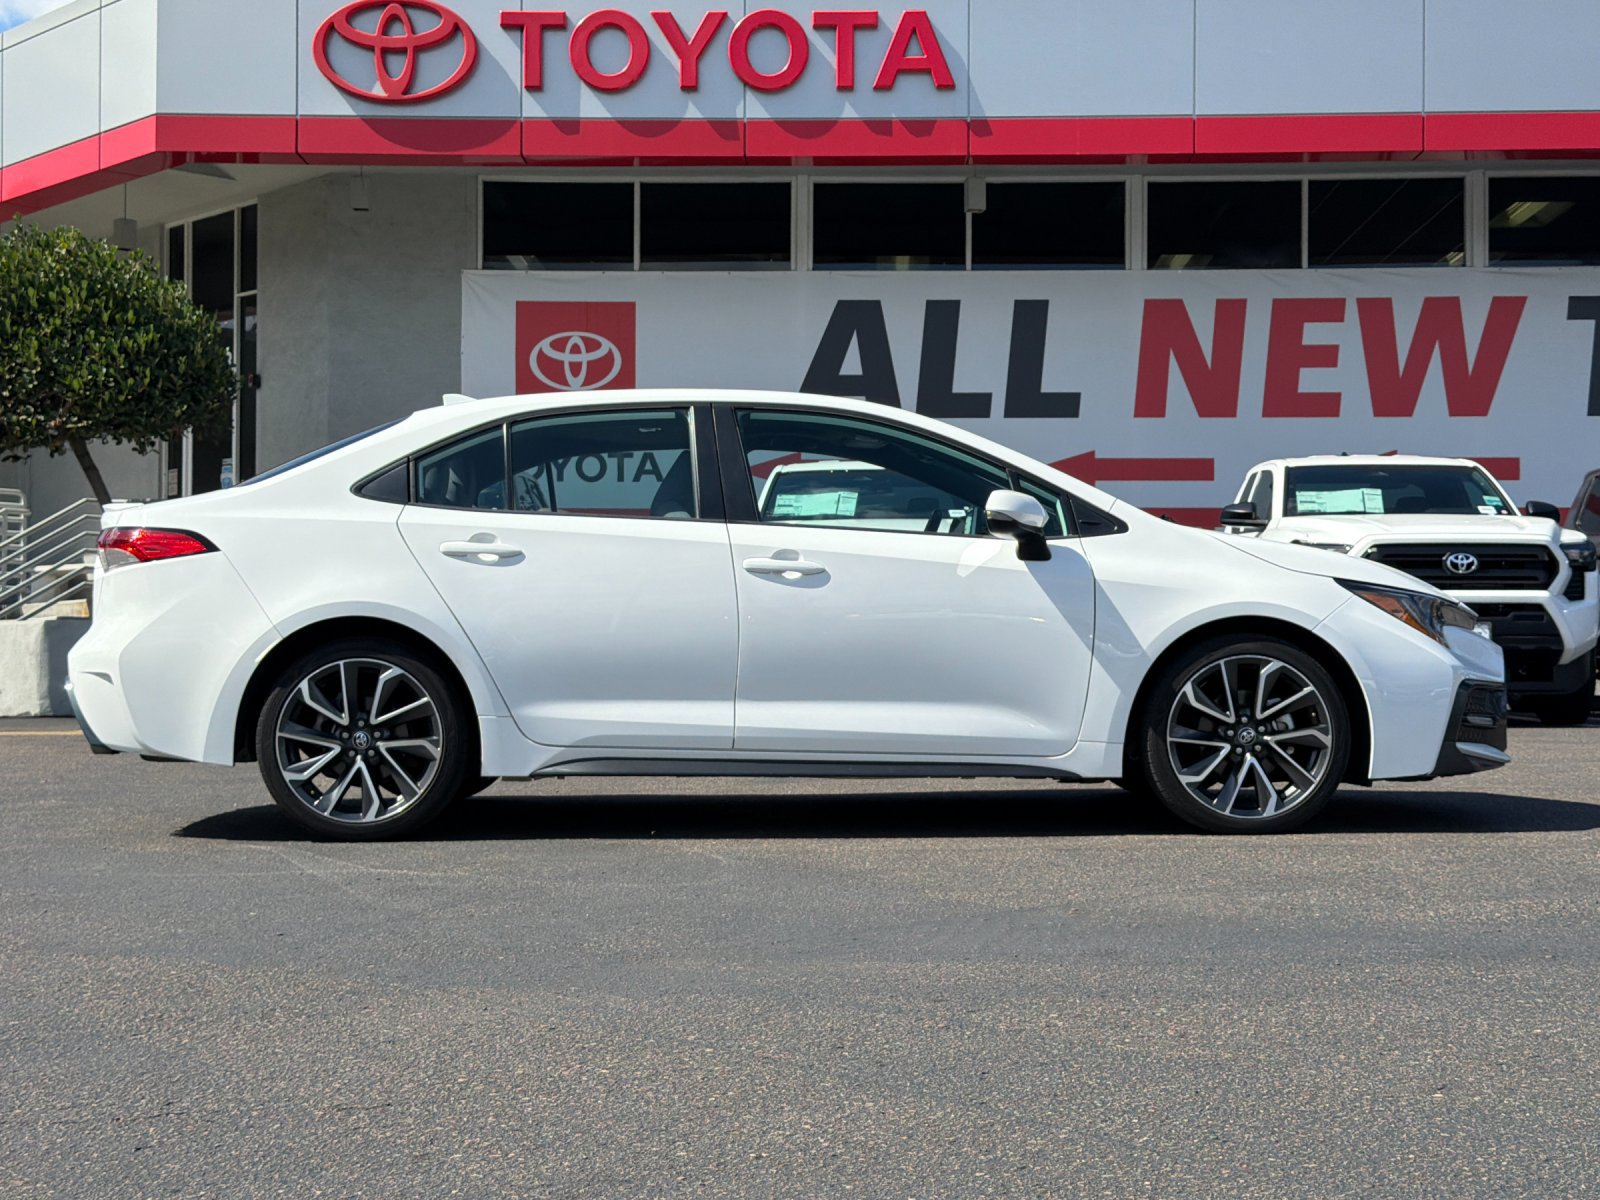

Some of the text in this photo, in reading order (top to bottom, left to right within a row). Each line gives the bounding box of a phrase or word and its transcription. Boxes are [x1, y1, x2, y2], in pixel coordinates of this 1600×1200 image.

[500, 9, 955, 92] TOYOTA
[798, 299, 1082, 418] ALL
[1133, 296, 1528, 418] NEW
[532, 452, 663, 483] YOTA
